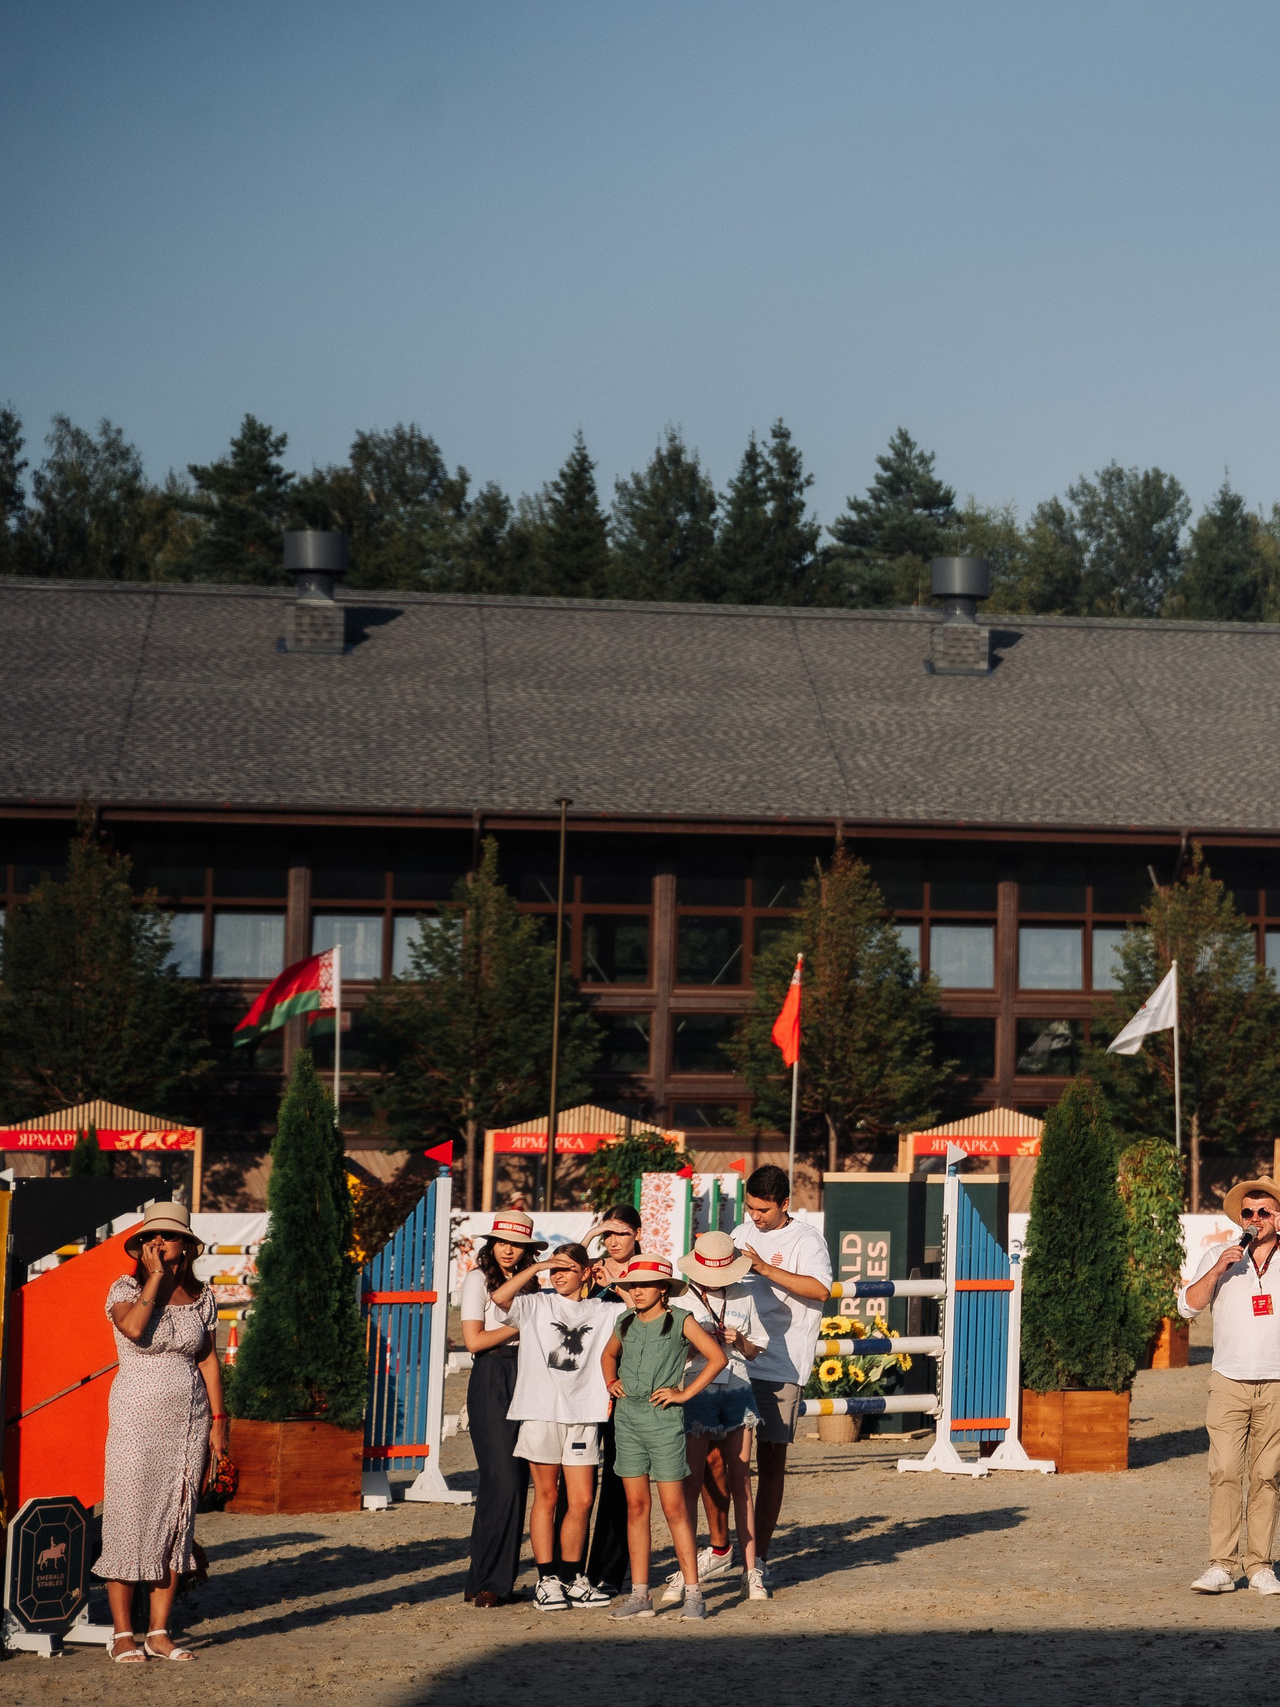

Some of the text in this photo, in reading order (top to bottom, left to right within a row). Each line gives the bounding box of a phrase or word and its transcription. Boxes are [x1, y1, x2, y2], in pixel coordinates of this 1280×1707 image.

[511, 1136, 585, 1149] ЯРМРКА
[36, 1573, 65, 1582] EMERALD
[37, 1580, 64, 1588] STABLES
